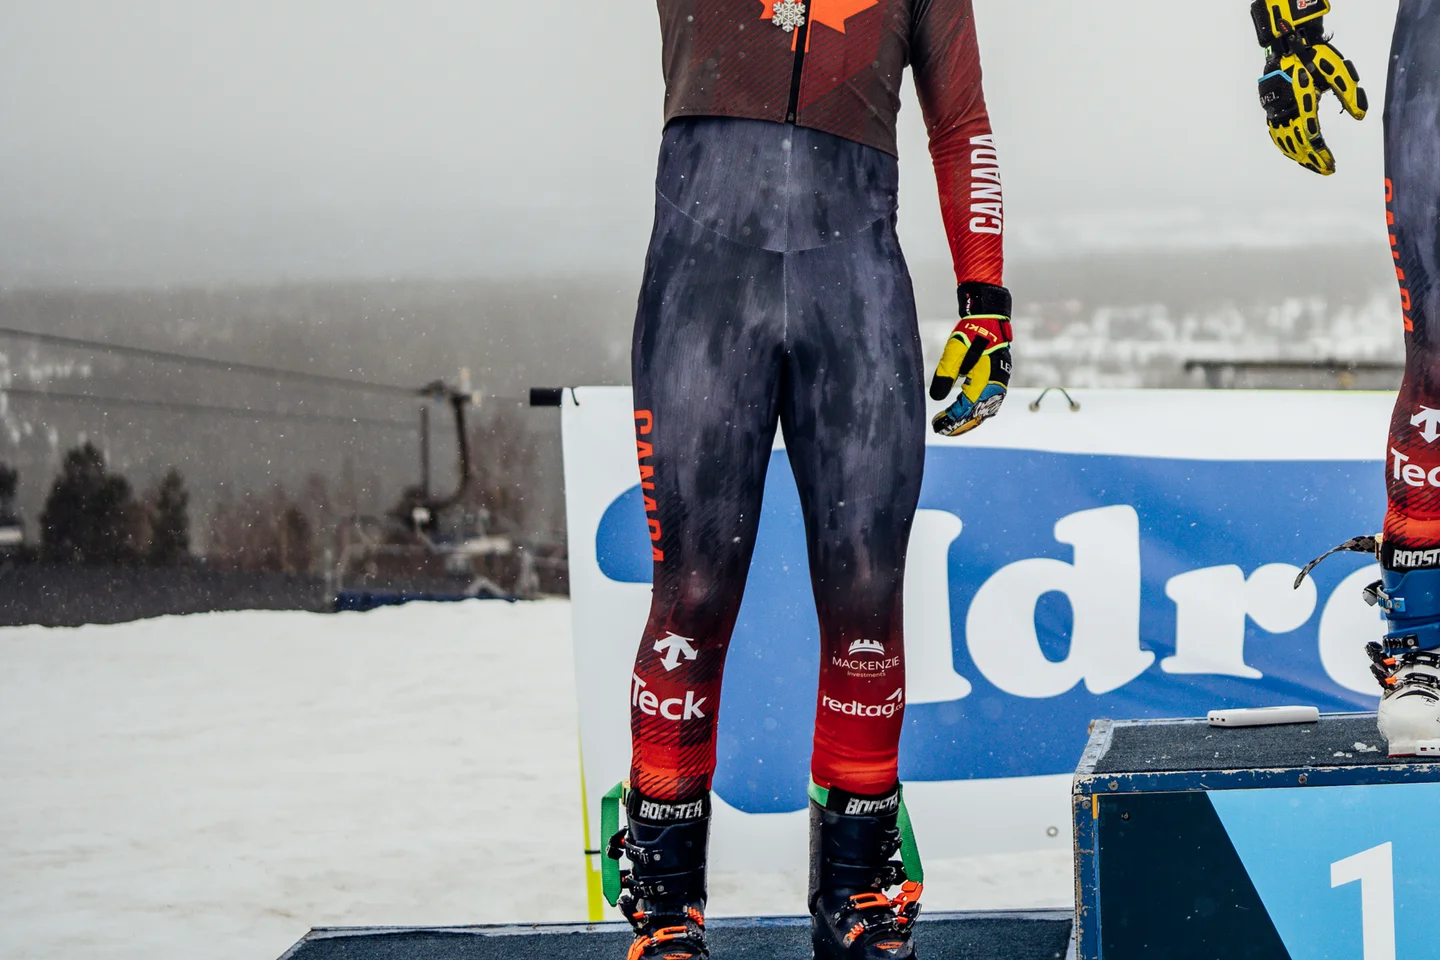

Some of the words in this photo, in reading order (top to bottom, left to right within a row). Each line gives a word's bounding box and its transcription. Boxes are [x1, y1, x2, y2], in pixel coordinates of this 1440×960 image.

[968, 132, 1003, 236] CANADA
[964, 322, 998, 343] LEKI
[831, 654, 901, 671] MACKENZIE
[631, 673, 708, 721] Teck
[638, 799, 705, 820] BOOSTER
[1329, 841, 1397, 960] 1
